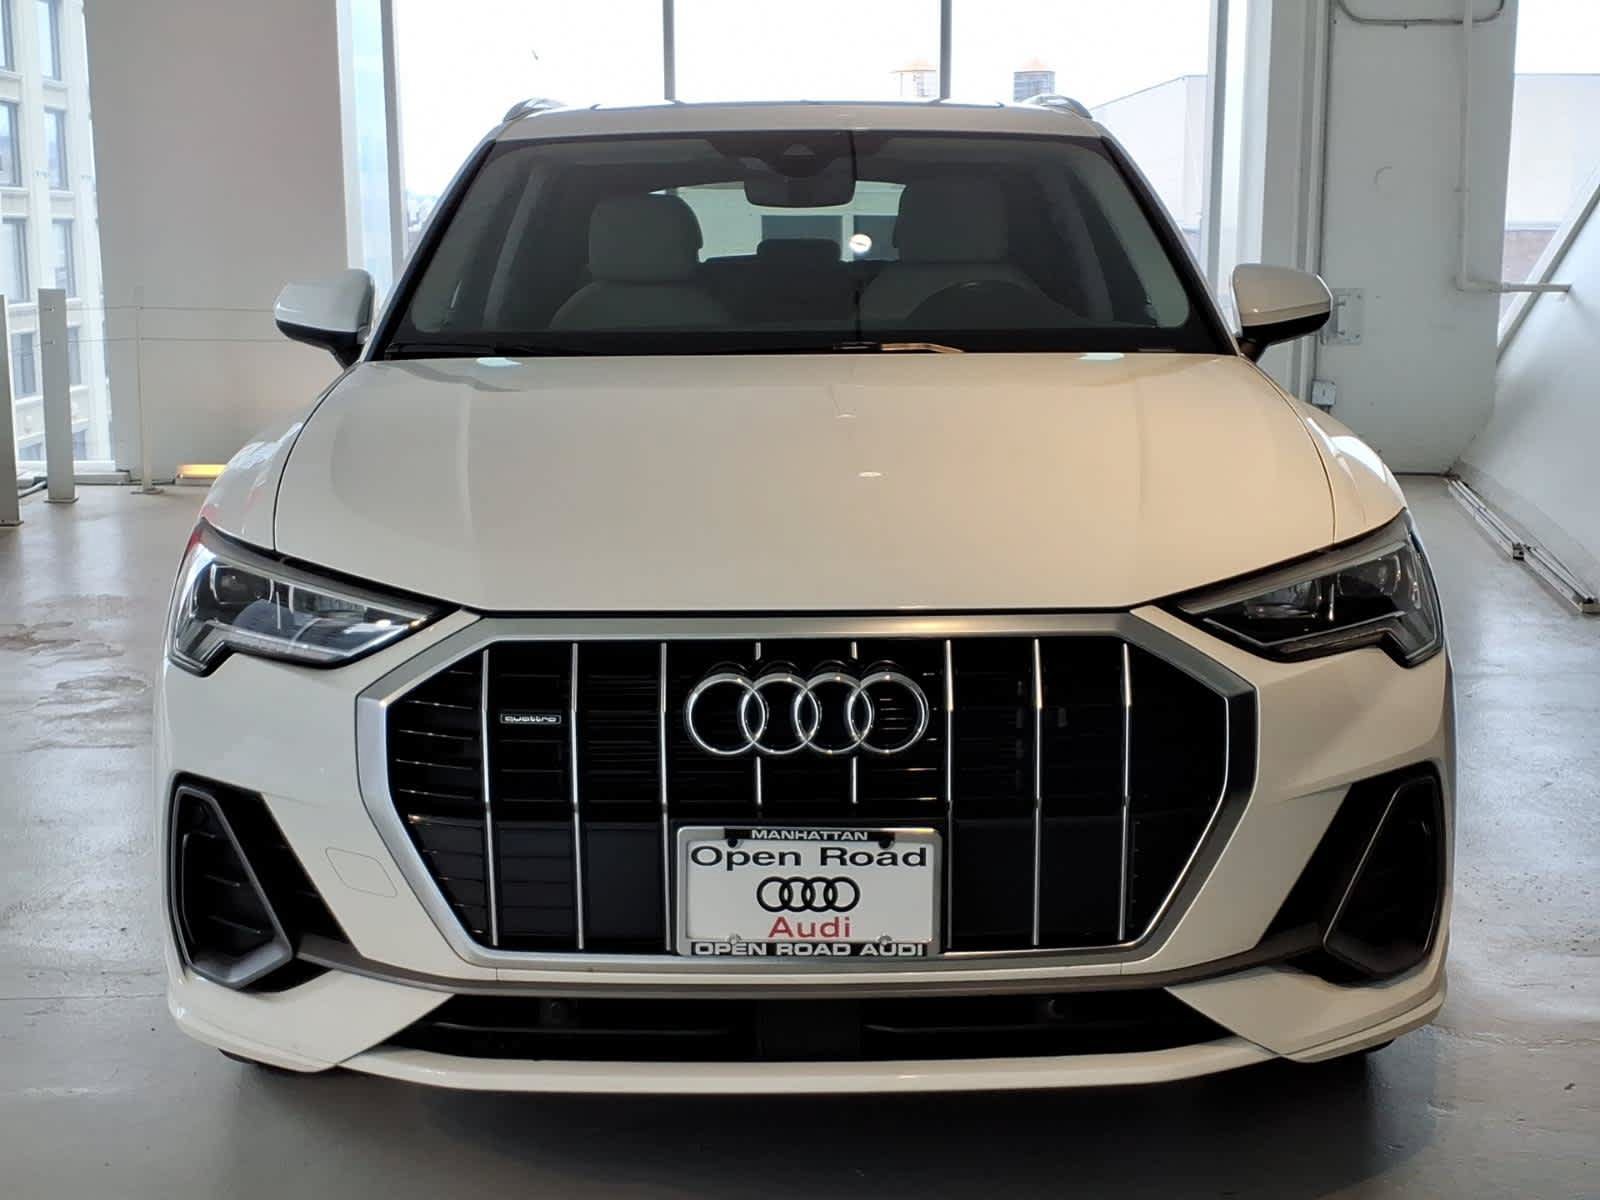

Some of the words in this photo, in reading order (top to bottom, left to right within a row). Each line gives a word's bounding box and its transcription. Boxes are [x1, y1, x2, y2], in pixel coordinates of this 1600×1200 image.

[751, 829, 868, 841] MANHATTAN
[690, 845, 801, 871] Open
[820, 846, 927, 867] Road
[768, 916, 851, 938] Audi
[695, 942, 767, 956] OPEN
[776, 942, 851, 956] ROAD
[860, 942, 924, 956] AUDI
